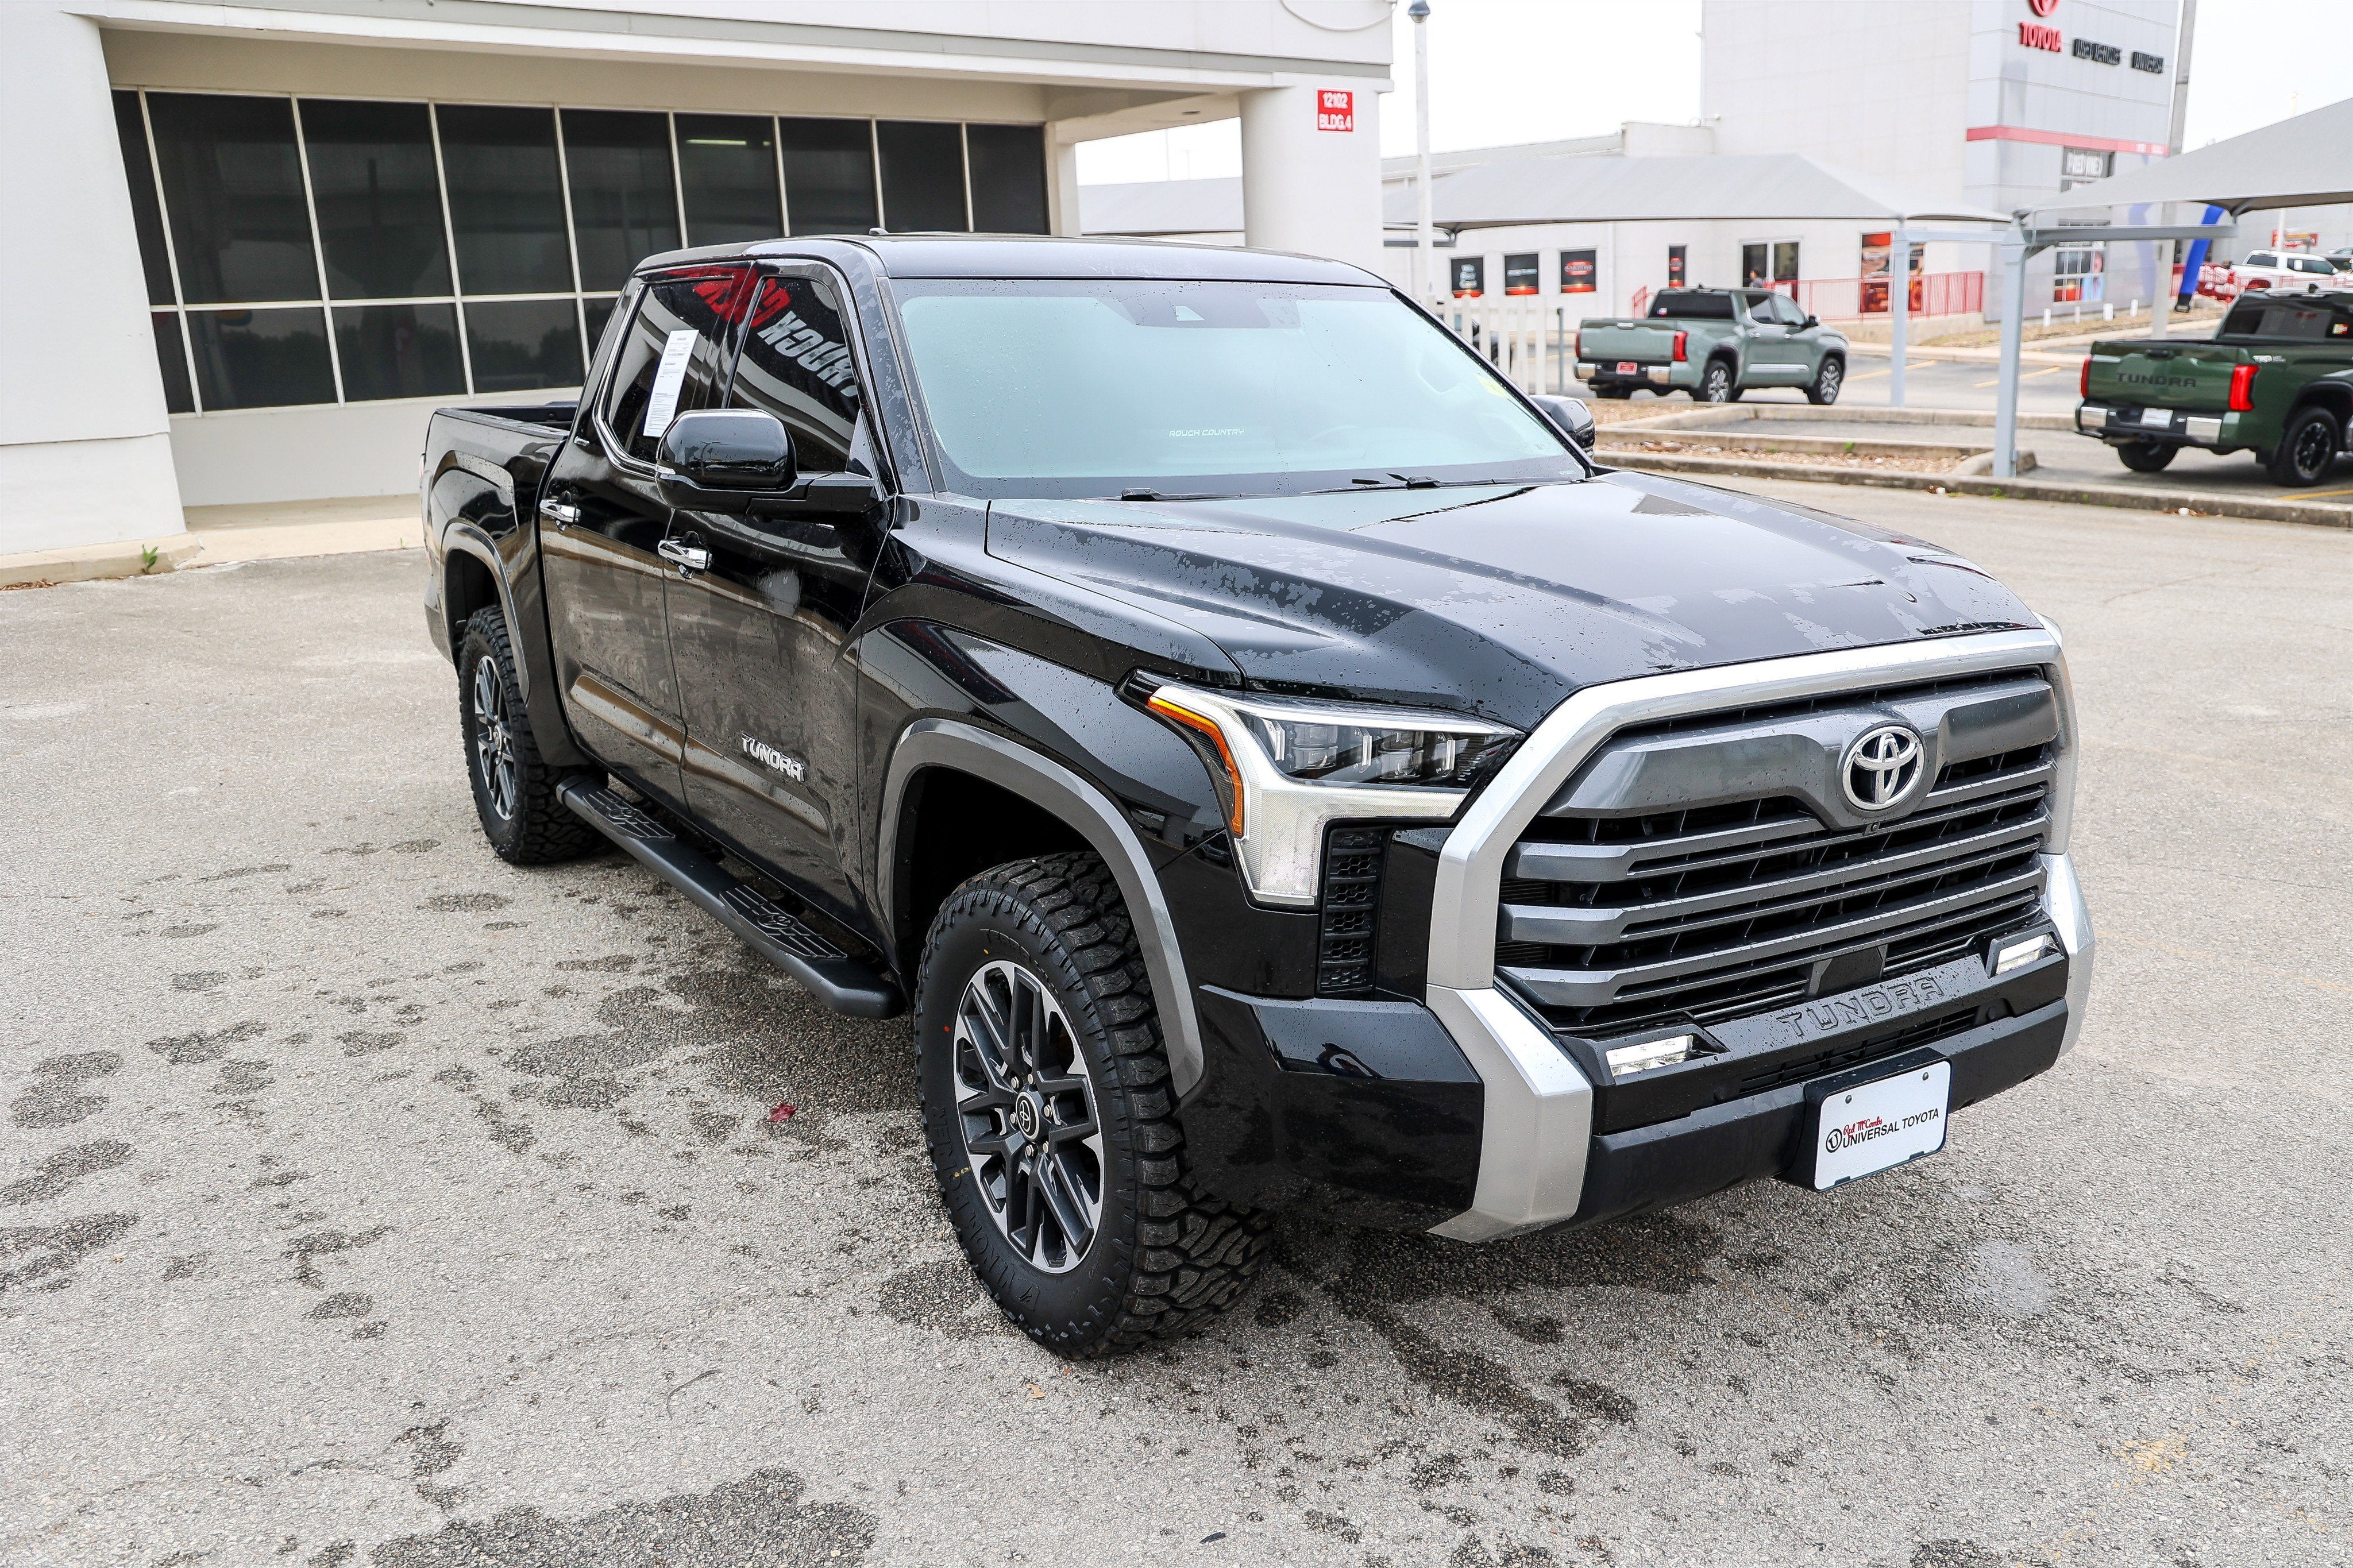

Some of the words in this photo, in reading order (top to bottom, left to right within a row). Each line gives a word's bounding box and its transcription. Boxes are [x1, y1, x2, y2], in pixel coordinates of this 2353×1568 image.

[2018, 21, 2063, 53] TOYOTA
[1322, 91, 1348, 109] 12102
[2117, 373, 2197, 388] TUNDRA
[1169, 429, 1200, 437] ROUGH
[1202, 428, 1245, 437] COUNTRY
[741, 733, 805, 782] TUNDRA
[1776, 976, 1945, 1036] TUNDRA
[1843, 1121, 1900, 1148] UNIVERSAL
[1902, 1108, 1939, 1129] TOYOTA
[1843, 1123, 1856, 1138] Red
